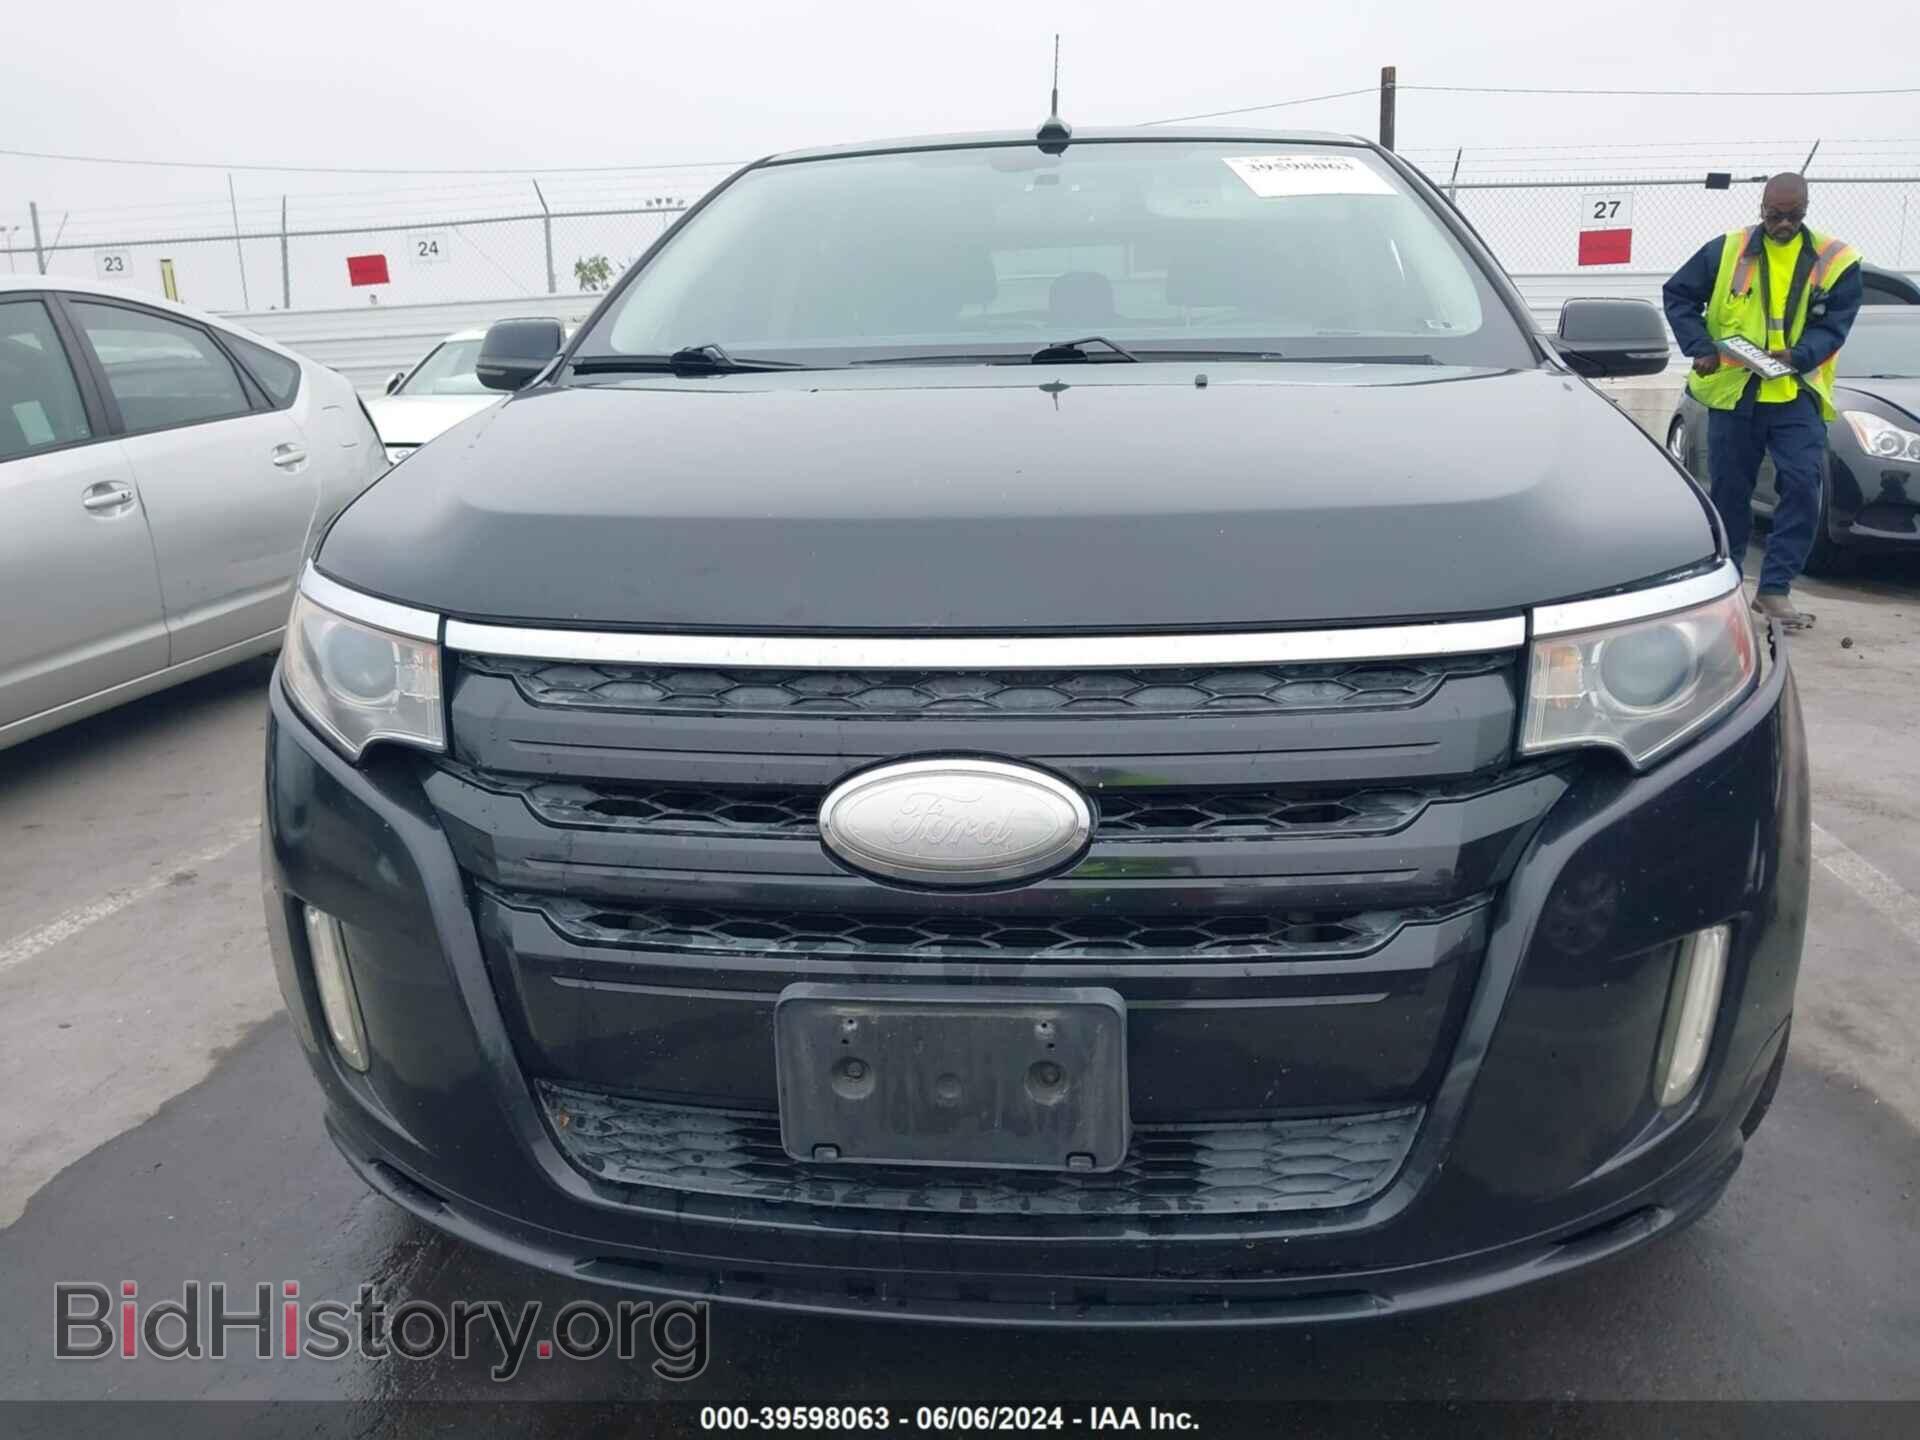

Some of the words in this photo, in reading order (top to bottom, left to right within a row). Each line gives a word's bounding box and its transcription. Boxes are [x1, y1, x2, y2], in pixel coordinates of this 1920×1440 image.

[1593, 201, 1621, 219] 27
[418, 241, 439, 257] 24
[104, 256, 124, 272] 23
[888, 792, 1017, 847] Ford
